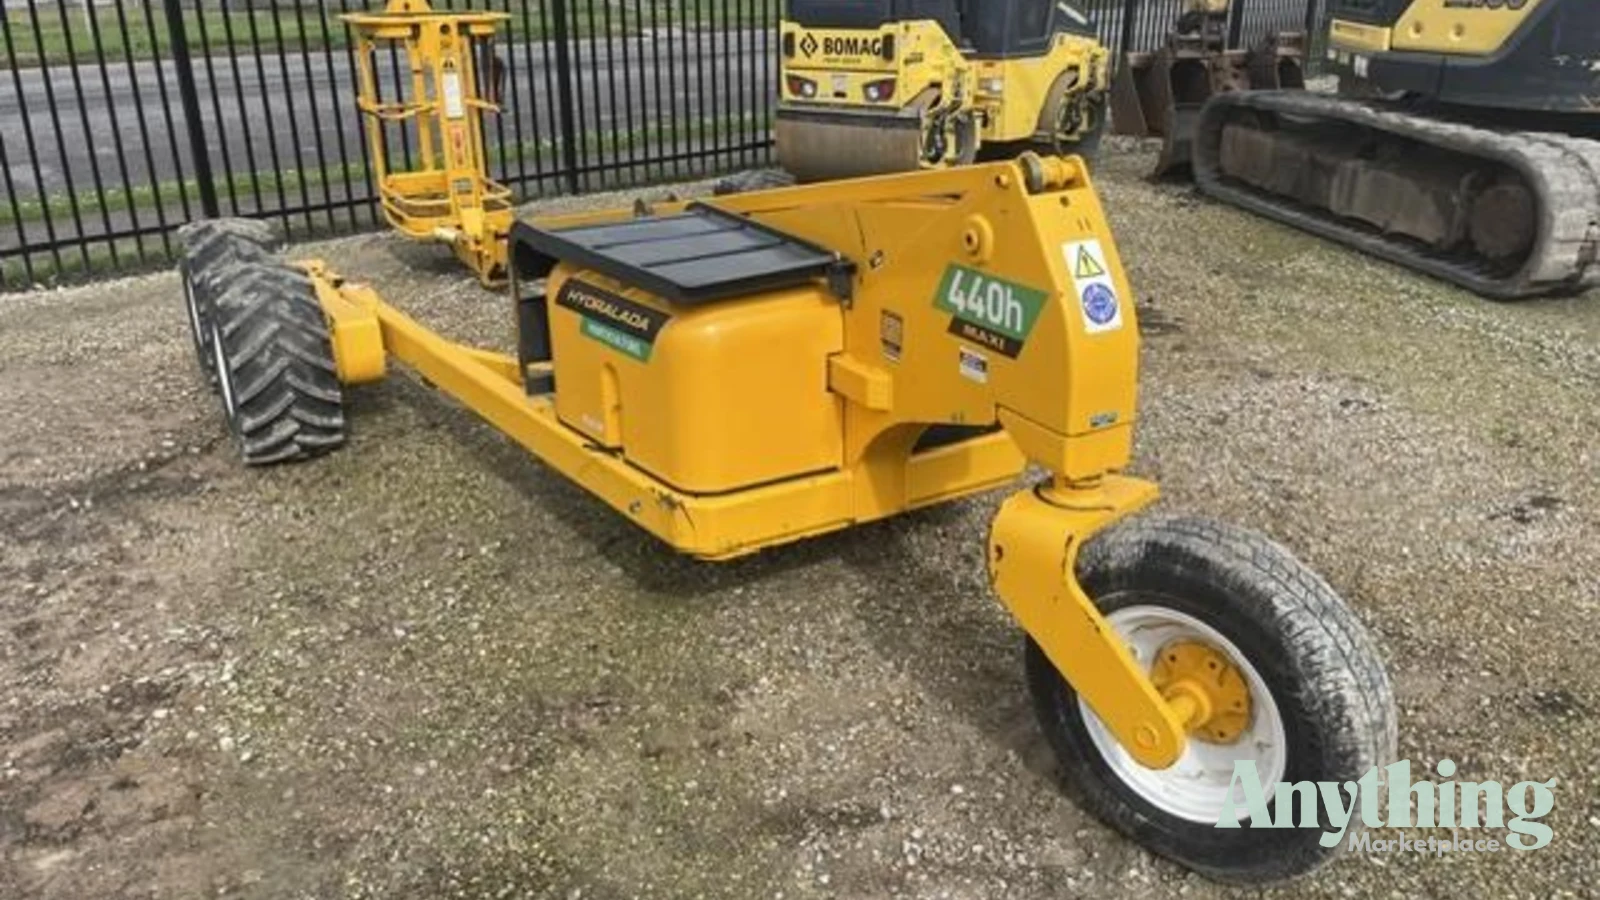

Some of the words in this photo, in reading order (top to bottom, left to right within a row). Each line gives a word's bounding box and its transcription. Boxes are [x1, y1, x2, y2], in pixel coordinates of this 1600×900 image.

[823, 37, 881, 56] BOMAG
[567, 289, 650, 331] HYDRALADA
[948, 269, 1023, 331] 440h
[961, 323, 1007, 351] MAXI
